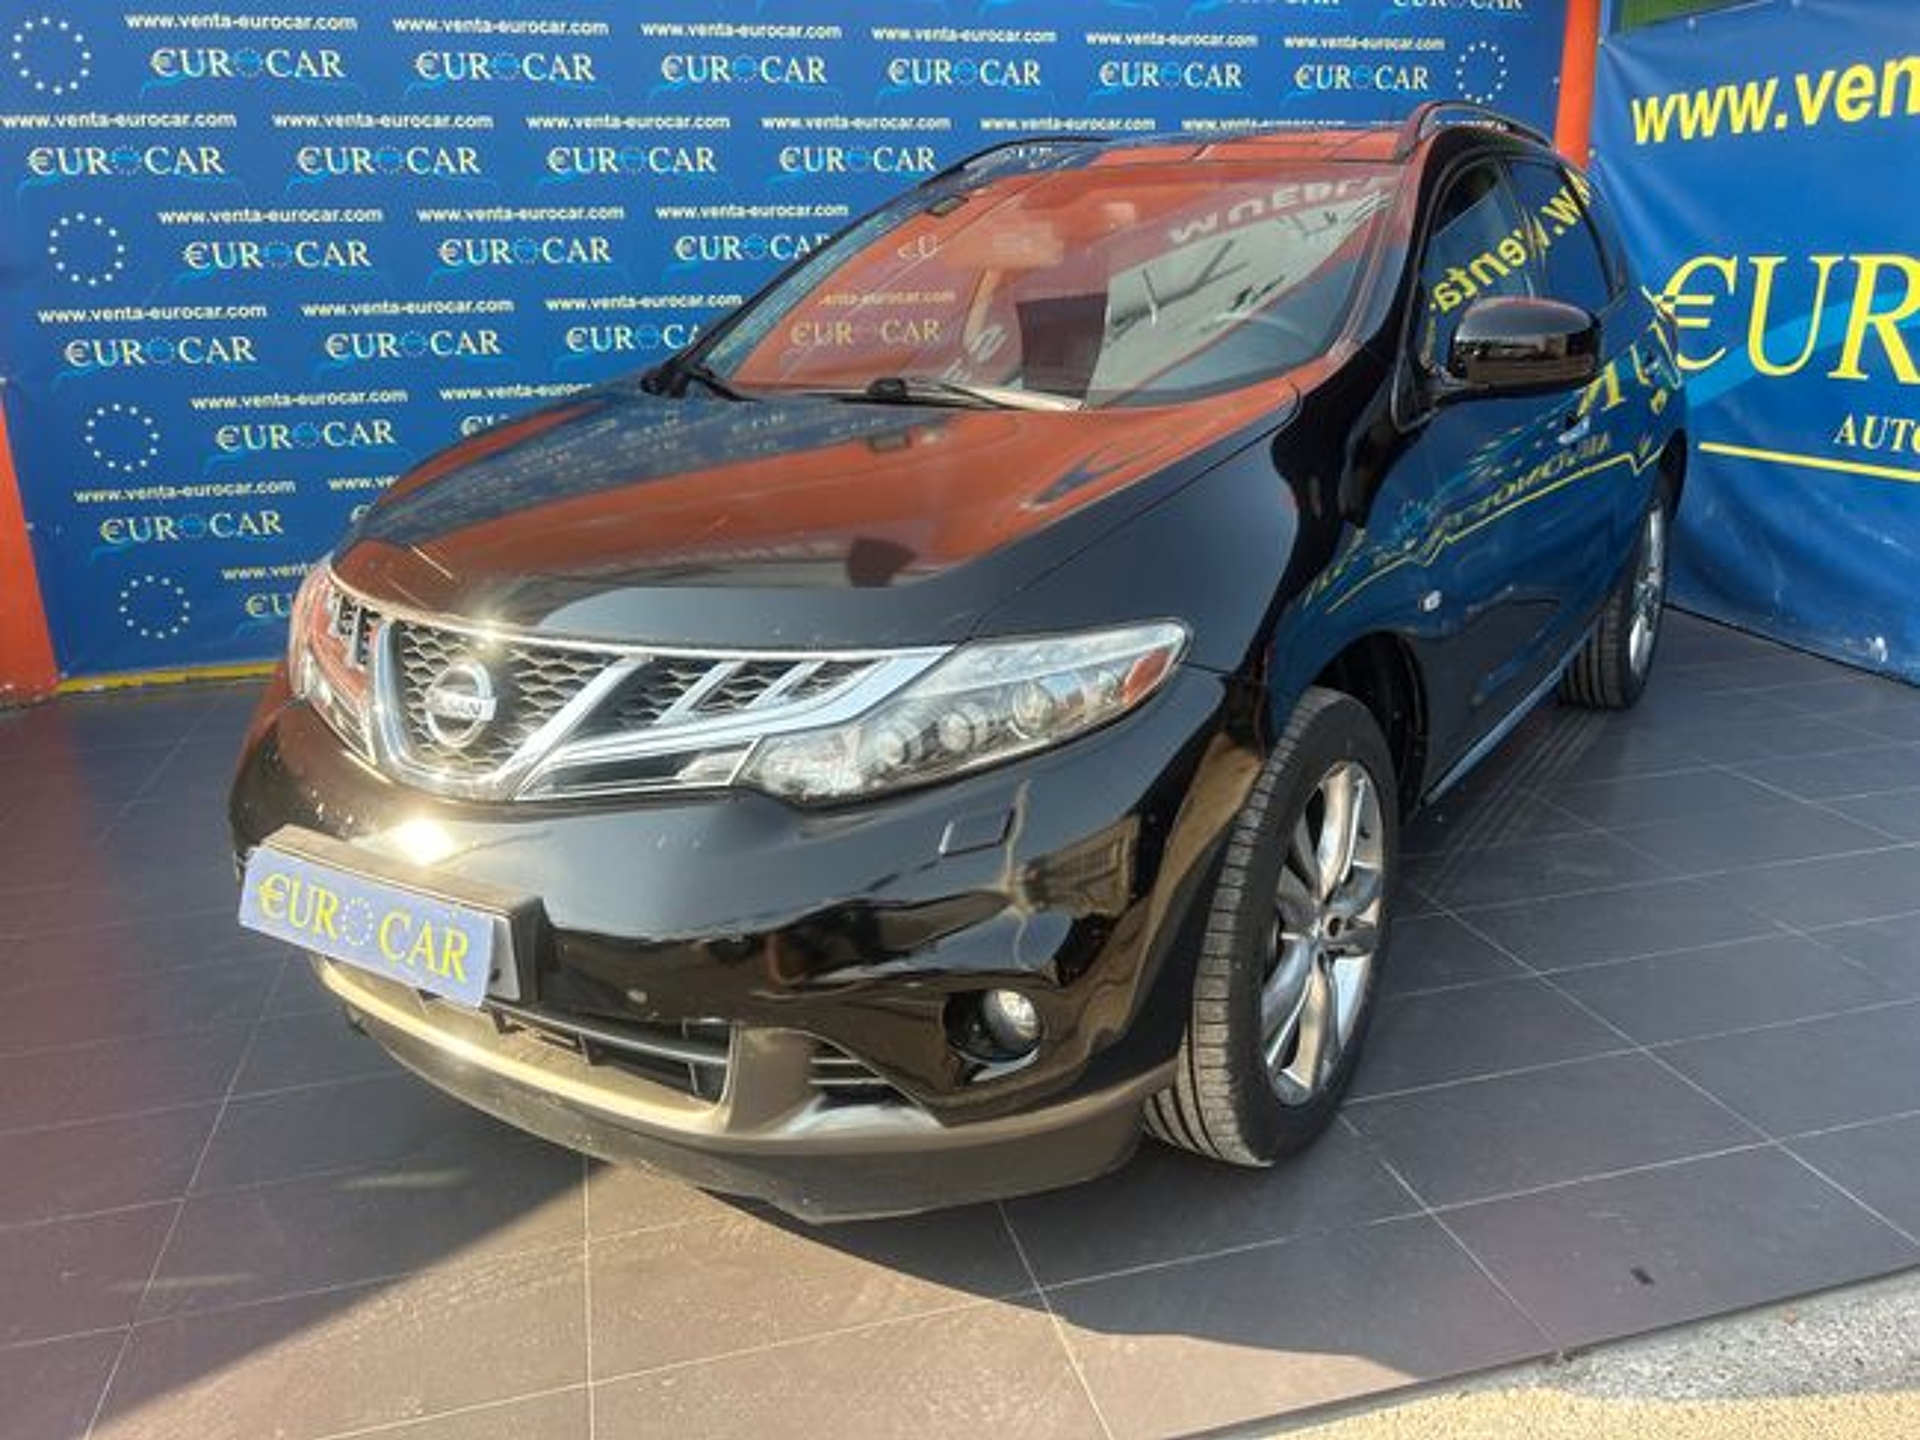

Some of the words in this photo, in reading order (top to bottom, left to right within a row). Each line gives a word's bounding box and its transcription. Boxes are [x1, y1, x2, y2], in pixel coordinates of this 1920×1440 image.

[125, 13, 358, 30] www.venta-eurocar.com
[392, 16, 609, 35] www.venta-eurocar.com
[641, 22, 842, 39] www.venta-eurocar.com
[871, 26, 1057, 43] www.venta-eurocar.com
[1085, 30, 1259, 47] www.venta-eurocar.com
[1284, 34, 1445, 51] www.venta-eurocar.com
[0, 112, 237, 128] www.venta-eurocar.com
[272, 112, 494, 130] www.venta-eurocar.com
[526, 113, 731, 131] www.venta-eurocar.com
[761, 114, 951, 131] www.venta-eurocar.com
[980, 117, 1155, 131] www.venta-eurocar.com
[158, 208, 383, 224] www.venta-eurocar.com
[417, 205, 624, 222] www.venta-eurocar.com
[656, 203, 849, 219] www.venta-eurocar.com
[674, 234, 829, 261] €UROCA
[302, 298, 514, 318] www.venta-eurocar.com
[546, 293, 742, 310] www.venta-eurocar.com
[38, 303, 267, 324] www.venta-eurocar.com
[191, 388, 408, 410] www.venta-eurocar.com
[75, 478, 296, 503] www.venta-eurocar.com
